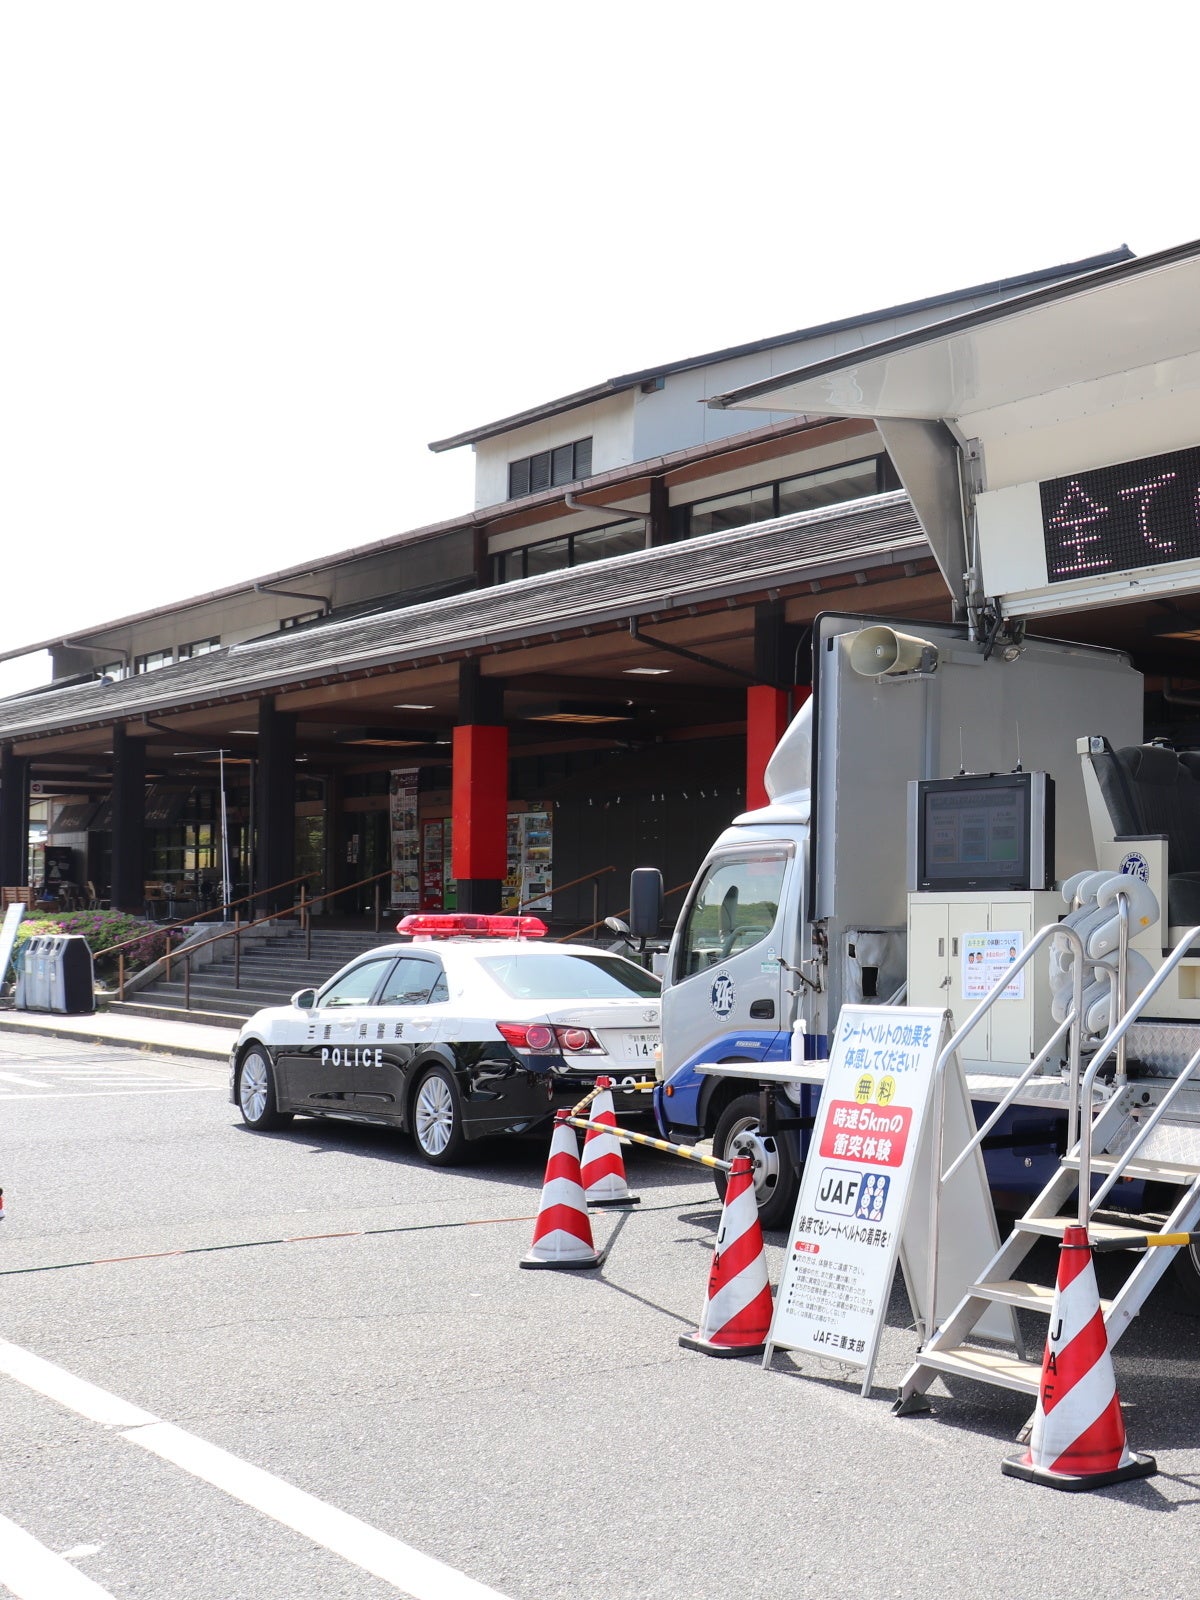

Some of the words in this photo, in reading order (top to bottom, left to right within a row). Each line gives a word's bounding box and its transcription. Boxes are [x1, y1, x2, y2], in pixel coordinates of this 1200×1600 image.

[842, 1021, 932, 1048] シートベルトの効果を
[321, 1047, 383, 1068] POLICE
[856, 1078, 892, 1103] 無料
[832, 1106, 904, 1134] 時速5kmの
[832, 1132, 893, 1163] 衝突体験
[820, 1178, 859, 1206] JAF
[709, 1226, 726, 1289] JAF
[813, 1329, 866, 1353] JAF三重支部
[1043, 1318, 1063, 1401] JAF
